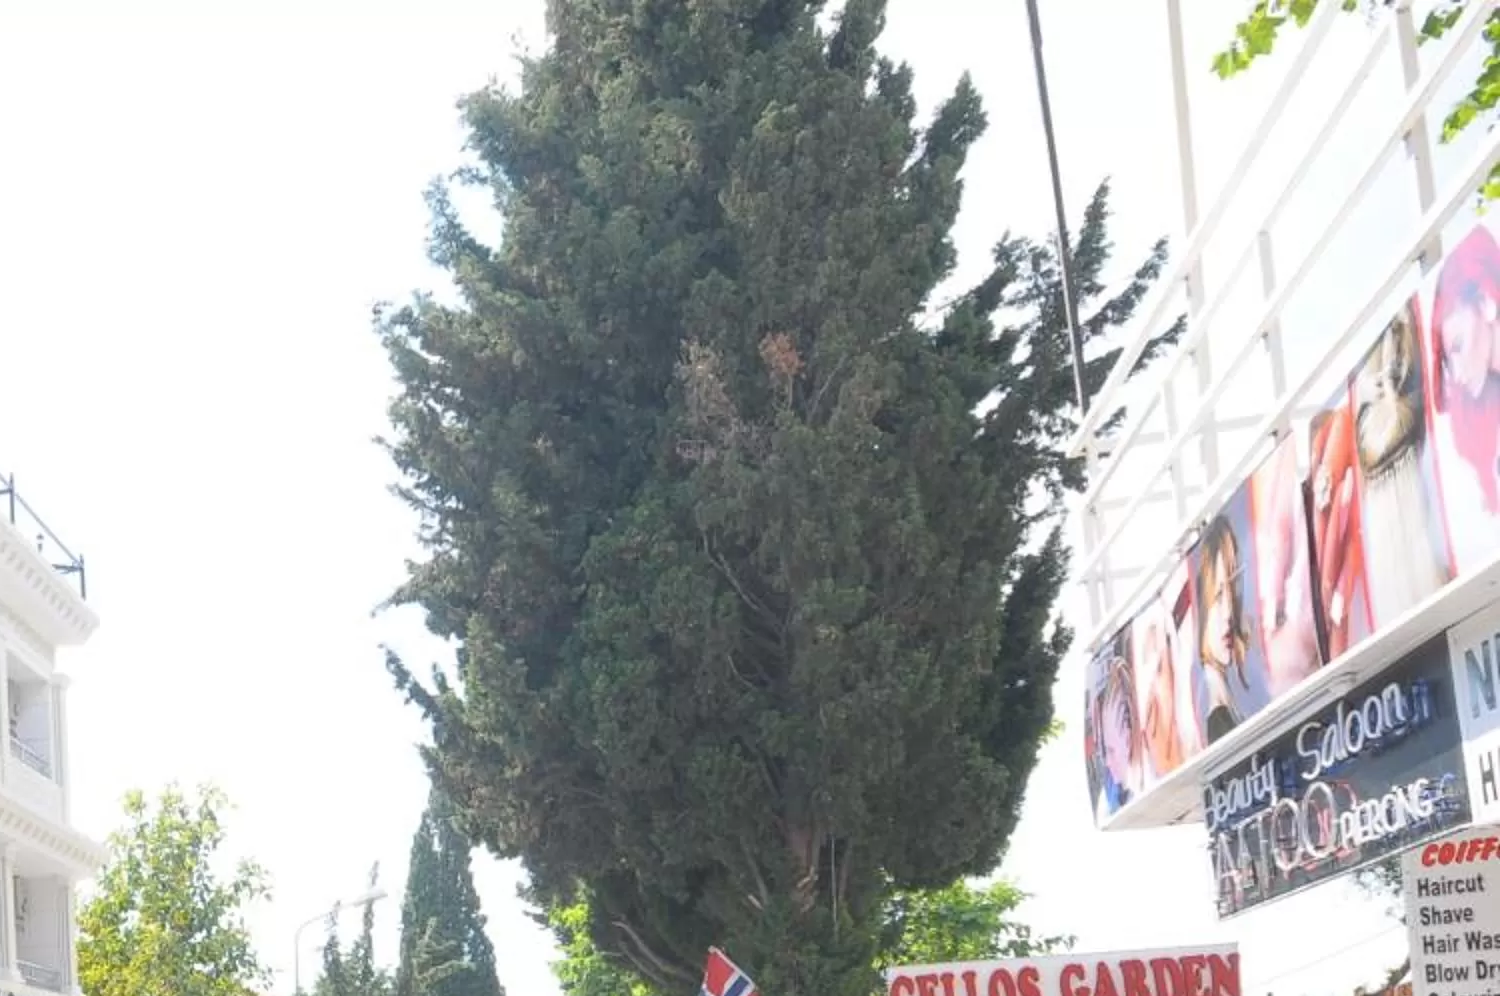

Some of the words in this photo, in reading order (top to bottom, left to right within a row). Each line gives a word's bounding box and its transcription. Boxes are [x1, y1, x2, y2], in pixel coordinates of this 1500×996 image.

[1296, 683, 1407, 780] Saloon
[1422, 837, 1500, 867] COIFF
[1417, 873, 1484, 898] Haircut
[1420, 904, 1474, 926] Shave
[1422, 934, 1460, 954] Hair
[1425, 963, 1469, 983] Blow
[1475, 959, 1500, 982] Dr
